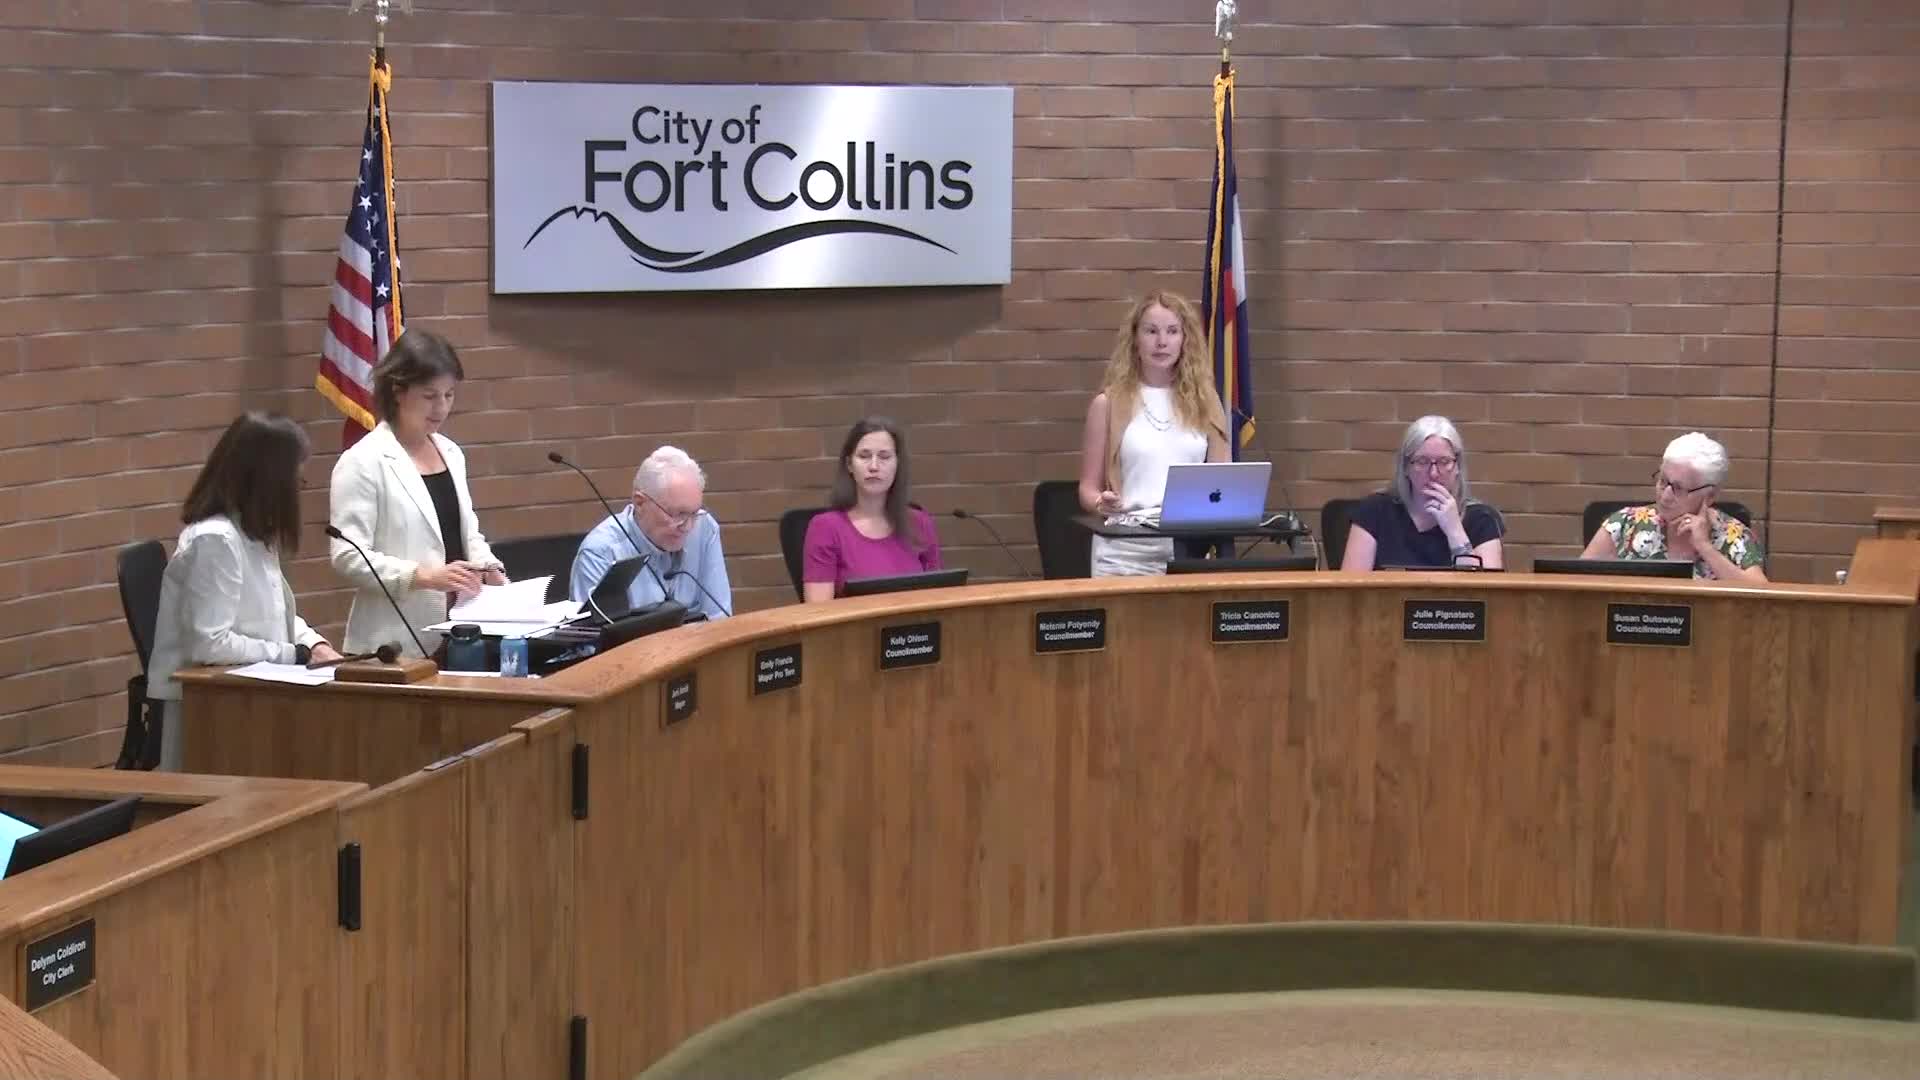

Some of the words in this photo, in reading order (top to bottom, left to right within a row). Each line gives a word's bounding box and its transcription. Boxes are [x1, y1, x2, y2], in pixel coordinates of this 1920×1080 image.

[632, 105, 713, 155] City
[720, 104, 761, 145] of
[584, 139, 729, 213] Fort
[743, 140, 974, 212] Collins
[1413, 610, 1433, 619] Julie
[1613, 613, 1640, 622] Susan
[1220, 622, 1280, 631] Councilmember
[1412, 621, 1476, 630] Councilmember
[1615, 624, 1682, 635] Councilmember
[1044, 631, 1095, 641] Councilmember
[885, 645, 934, 658] Councilmember
[57, 940, 86, 960] Coldiron
[43, 972, 56, 985] City
[57, 963, 75, 979] Clerk
